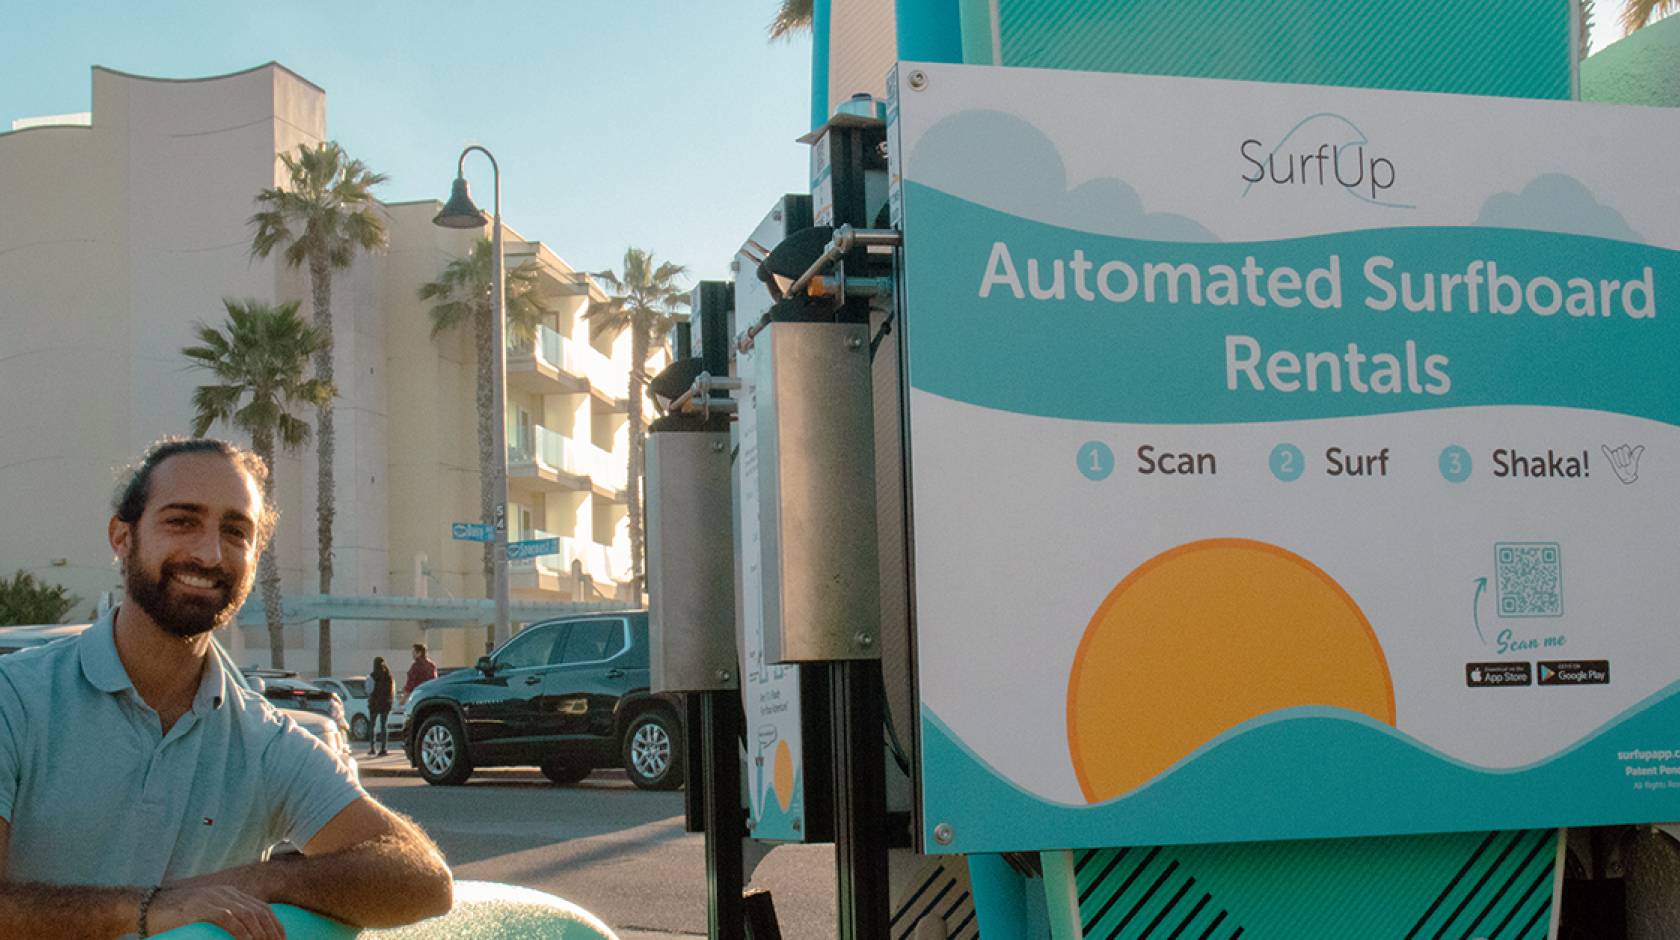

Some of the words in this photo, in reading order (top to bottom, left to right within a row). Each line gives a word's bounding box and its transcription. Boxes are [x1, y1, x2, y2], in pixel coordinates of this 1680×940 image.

[1240, 139, 1396, 200] SurfUp
[978, 241, 1343, 309] Automated
[1363, 256, 1657, 320] Surfboard
[1225, 335, 1452, 396] Rentals
[1137, 445, 1217, 475] Scan
[1325, 447, 1390, 476] Surf
[1492, 448, 1590, 478] Shaka!
[1496, 628, 1540, 655] Scan
[1543, 635, 1567, 647] me
[1484, 672, 1503, 684] App
[1504, 671, 1529, 682] Store
[1558, 669, 1588, 683] Google
[1588, 669, 1606, 681] Play
[1625, 766, 1657, 776] Patent
